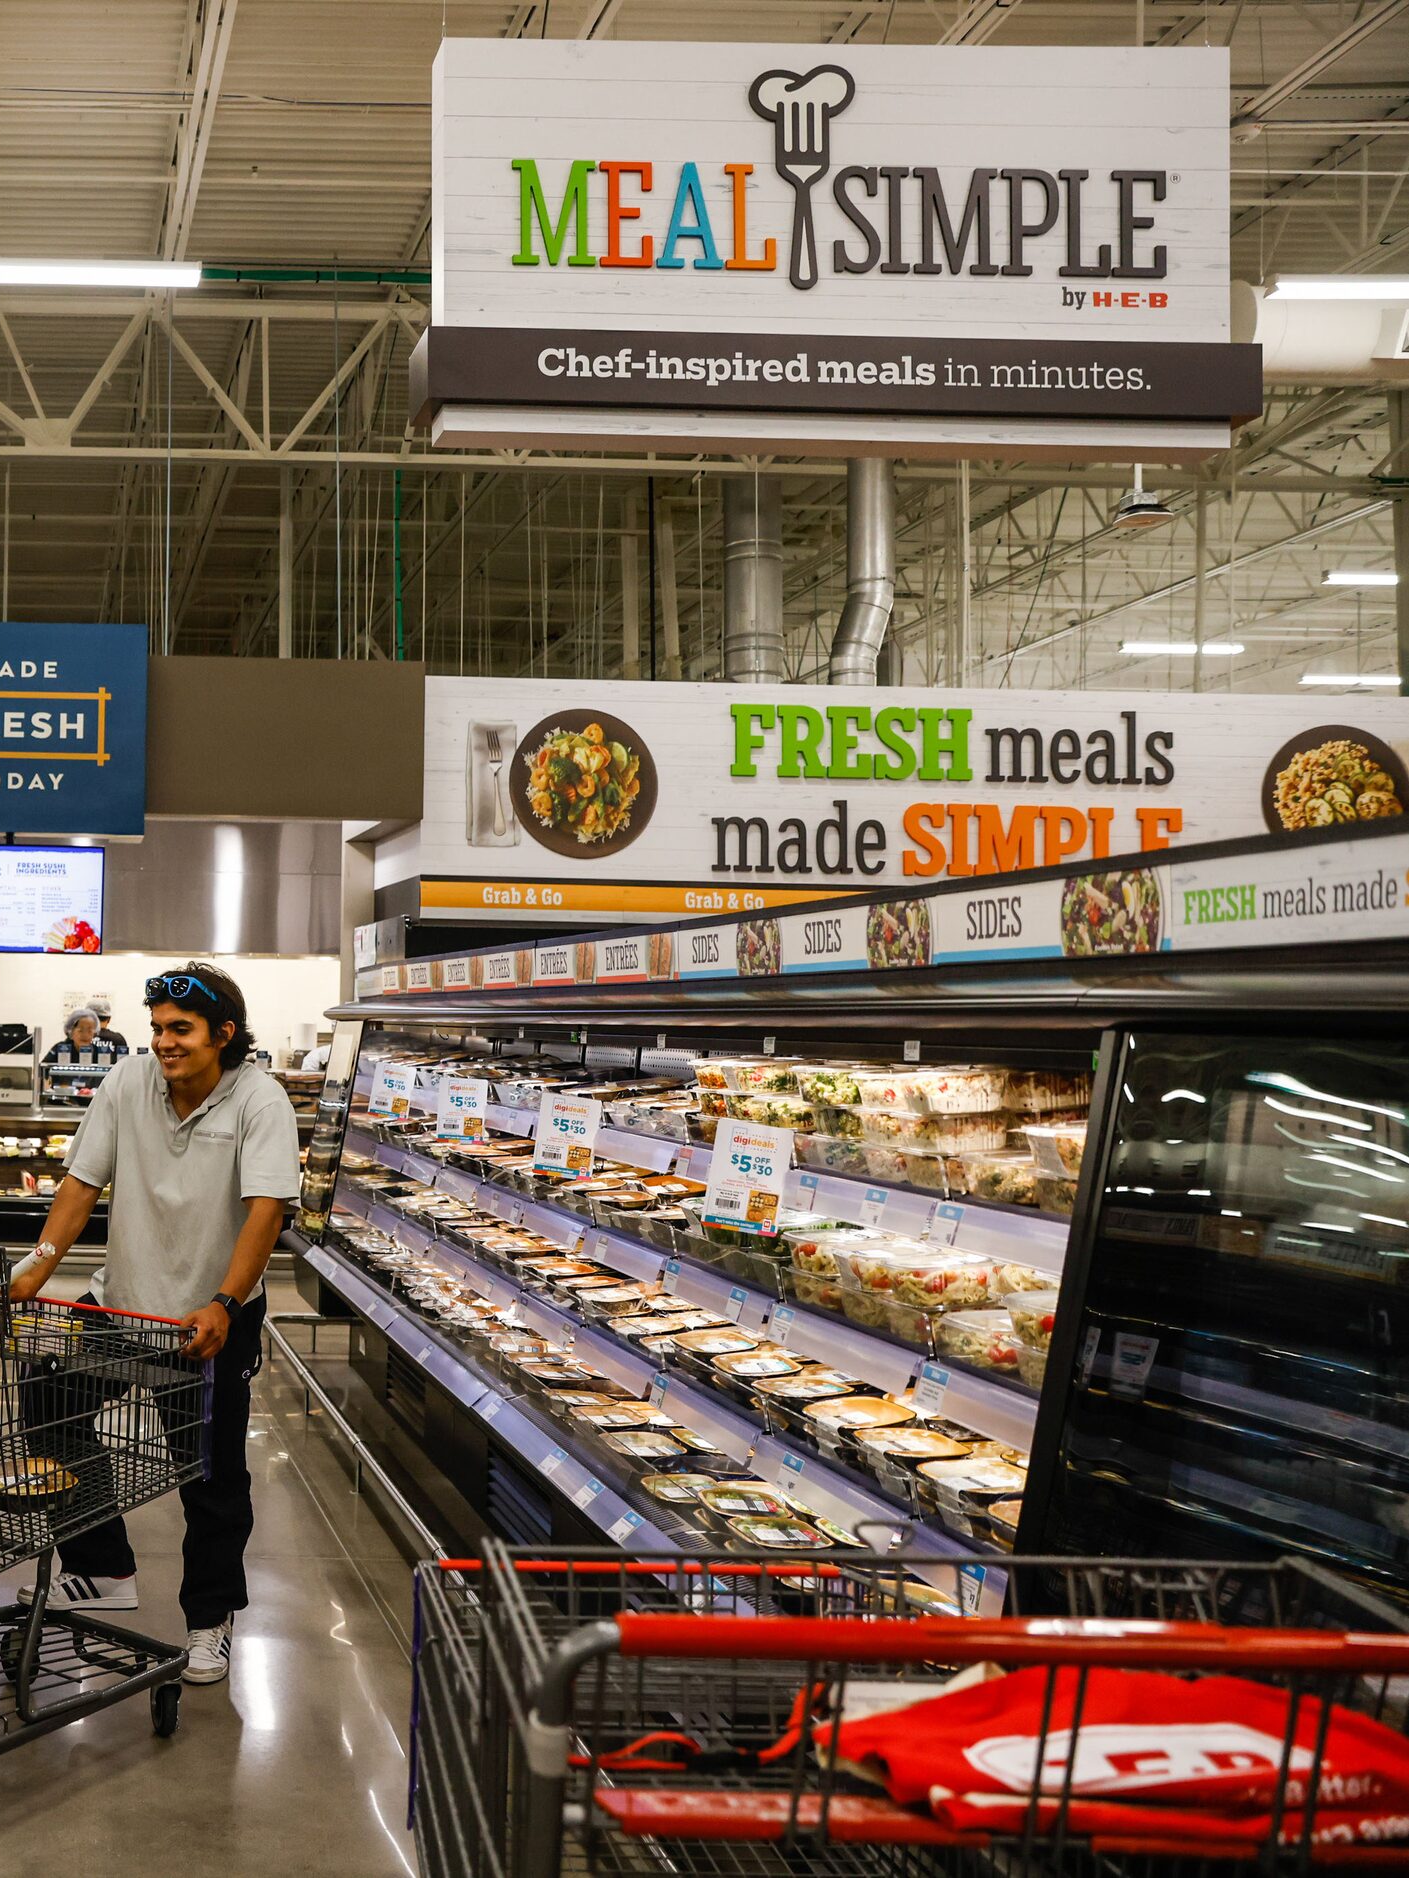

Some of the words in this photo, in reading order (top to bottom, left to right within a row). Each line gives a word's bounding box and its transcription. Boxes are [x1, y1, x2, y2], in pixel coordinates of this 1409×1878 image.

[510, 158, 778, 271] MEAL
[832, 165, 1168, 279] SIMPLE
[1061, 287, 1088, 310] by
[1092, 291, 1169, 309] H-E-B
[537, 347, 810, 386] Chef-inspired
[818, 355, 936, 387] meals
[944, 358, 981, 388] in
[989, 358, 1153, 391] minutes.
[730, 703, 973, 781] FRESH
[985, 711, 1174, 786] meals
[710, 800, 887, 875] made
[482, 886, 520, 904] Grab
[525, 888, 538, 904] &
[542, 888, 563, 906] Go
[685, 891, 723, 909] Grab
[726, 893, 740, 909] &
[743, 893, 764, 910] Go
[1183, 883, 1257, 926] FRESH
[1262, 877, 1326, 919] meals
[1332, 869, 1398, 914] made
[966, 896, 1022, 941] SIDES
[692, 933, 720, 964] SIDES
[804, 918, 843, 956] SIDES
[489, 953, 511, 980] ENTRÉES
[540, 946, 568, 976] ENTRÉES
[605, 939, 638, 972] ENTRÉES
[383, 1078, 395, 1089] $5
[449, 1096, 463, 1107] $5
[554, 1103, 587, 1115] digideals
[552, 1117, 570, 1132] $5
[570, 1125, 586, 1135] $30
[733, 1135, 775, 1149] digideals
[730, 1154, 752, 1173] $5
[754, 1156, 771, 1165] OFF
[752, 1164, 773, 1176] $30
